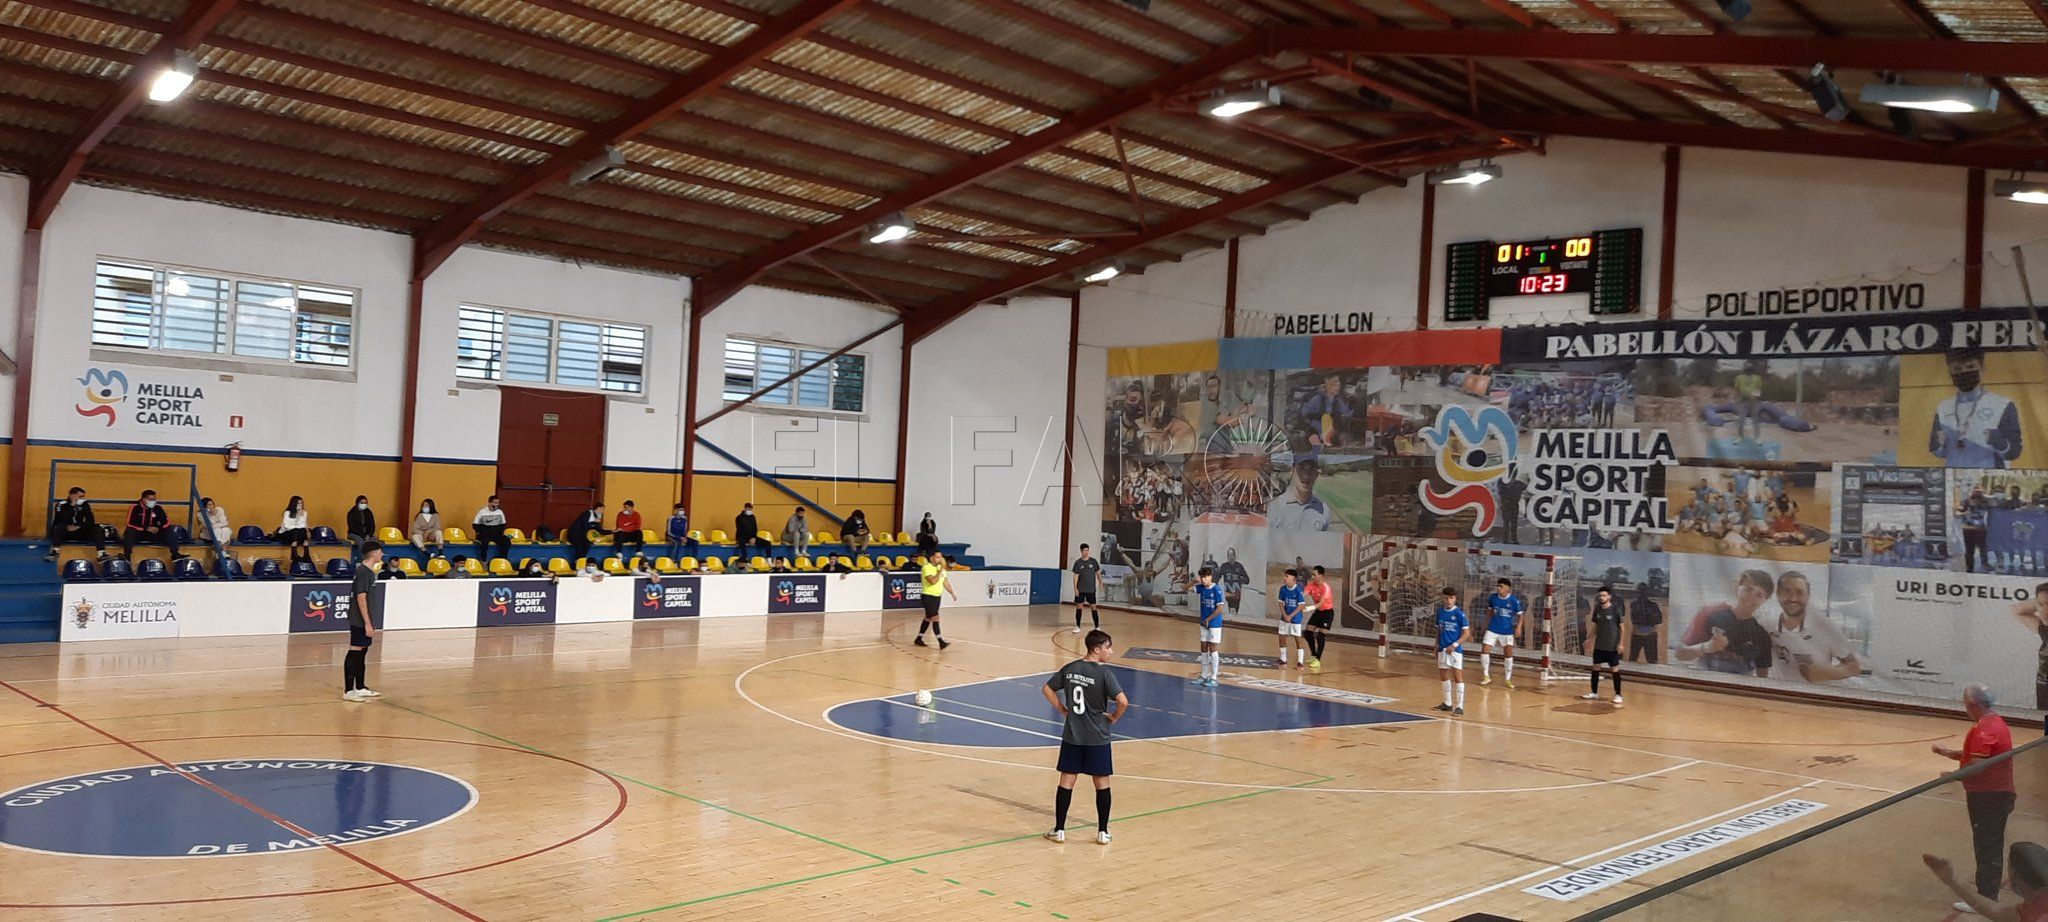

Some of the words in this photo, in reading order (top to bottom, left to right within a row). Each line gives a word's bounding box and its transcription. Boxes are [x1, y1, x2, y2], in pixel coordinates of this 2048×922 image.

[1565, 238, 1591, 257] 00
[1492, 266, 1518, 275] LOCAL
[1520, 274, 1565, 293] 10:23
[1706, 283, 1925, 317] POLIDEPORTIVO
[1274, 311, 1373, 335] PABELLON
[1545, 324, 1743, 358] PABELLÓN
[1750, 322, 1938, 354] LÁZARO
[137, 383, 203, 399] MELILLA
[137, 397, 191, 412] SPORT
[136, 412, 203, 427] CAPITAL
[1535, 432, 1676, 460] MELILLA
[1535, 464, 1648, 493] SPORT
[1533, 496, 1675, 529] CAPITAL
[515, 591, 547, 599] MELILLA
[998, 587, 1027, 595] MELILLA
[1896, 580, 1928, 595] URI
[1936, 583, 2030, 601] BOTELLO
[103, 610, 176, 624] MELILLA
[1073, 685, 1085, 715] 9
[5, 773, 134, 807] CIUDAD
[150, 760, 375, 777] AUTÓNOMA
[186, 843, 249, 855] DE
[268, 818, 418, 851] MELILLA
[1536, 849, 1675, 896] FERNÁNDEZ
